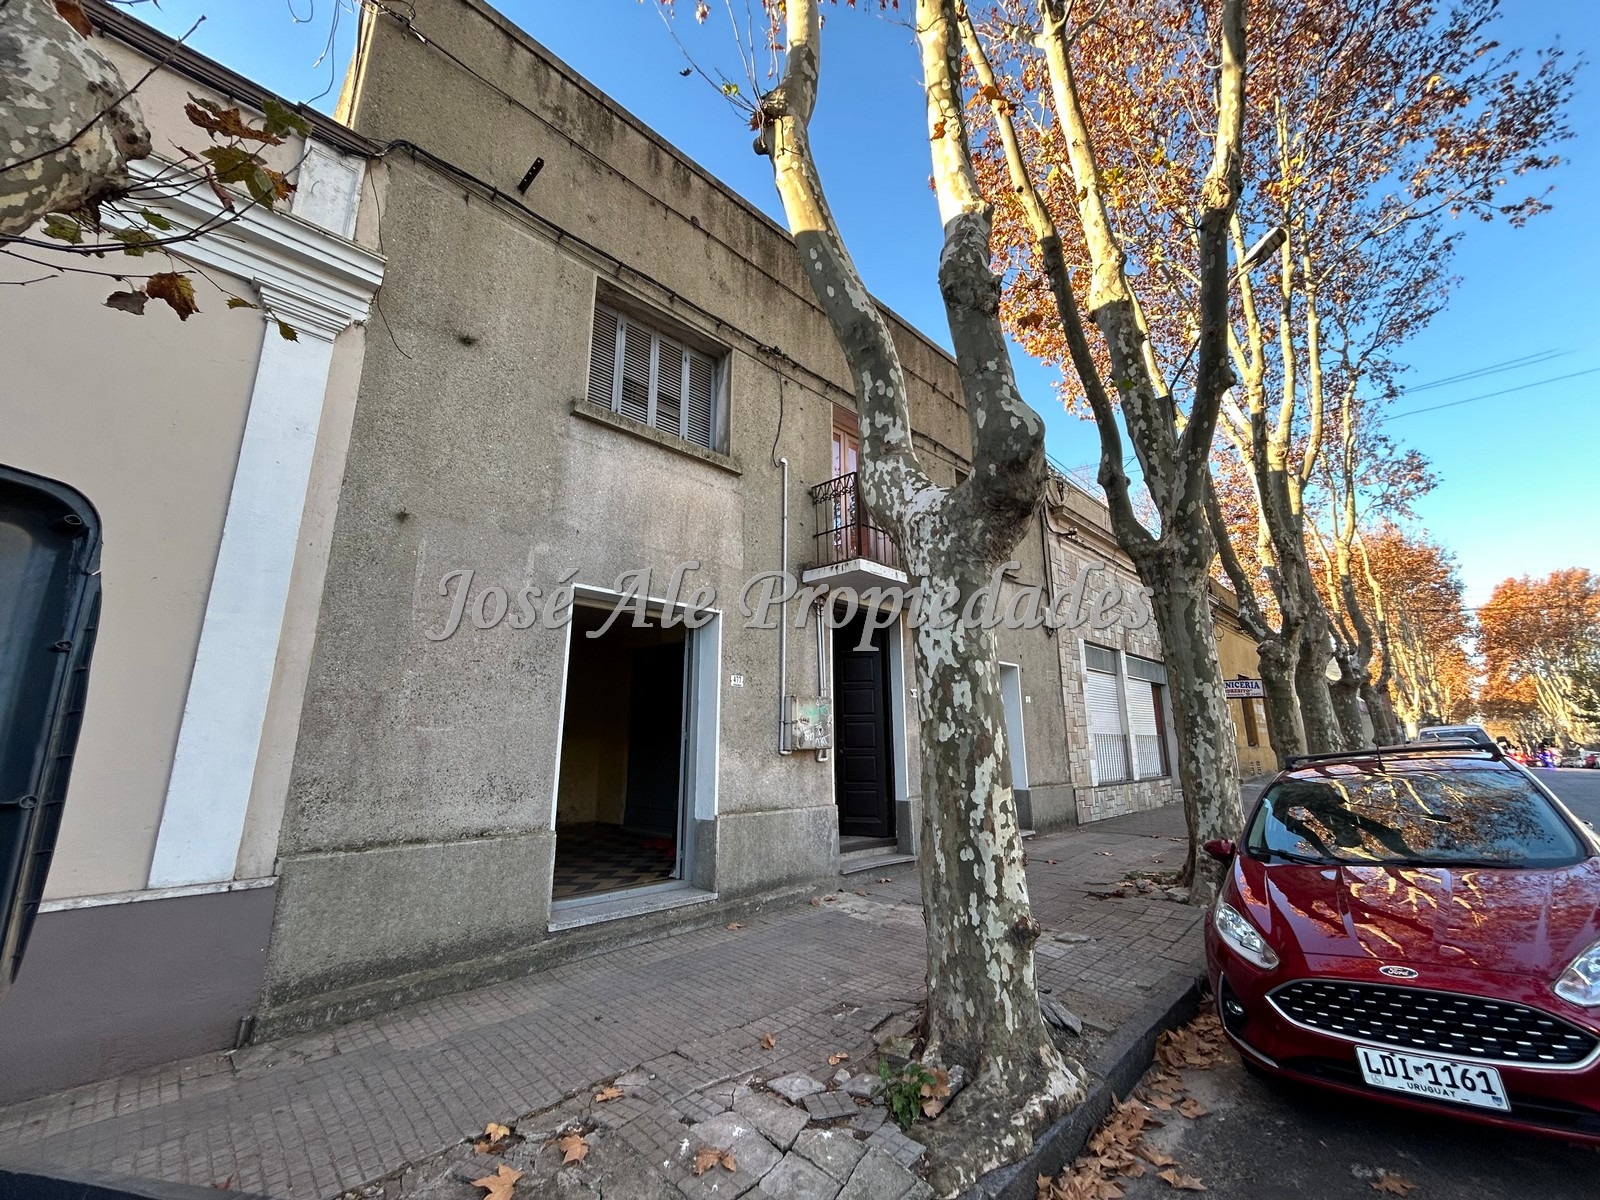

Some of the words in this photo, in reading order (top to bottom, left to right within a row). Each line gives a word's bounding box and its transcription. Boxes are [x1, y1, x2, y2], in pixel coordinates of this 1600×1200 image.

[1224, 681, 1260, 689] NICERIA
[1387, 967, 1409, 976] Ford
[1406, 1082, 1456, 1098] URUGUAY
